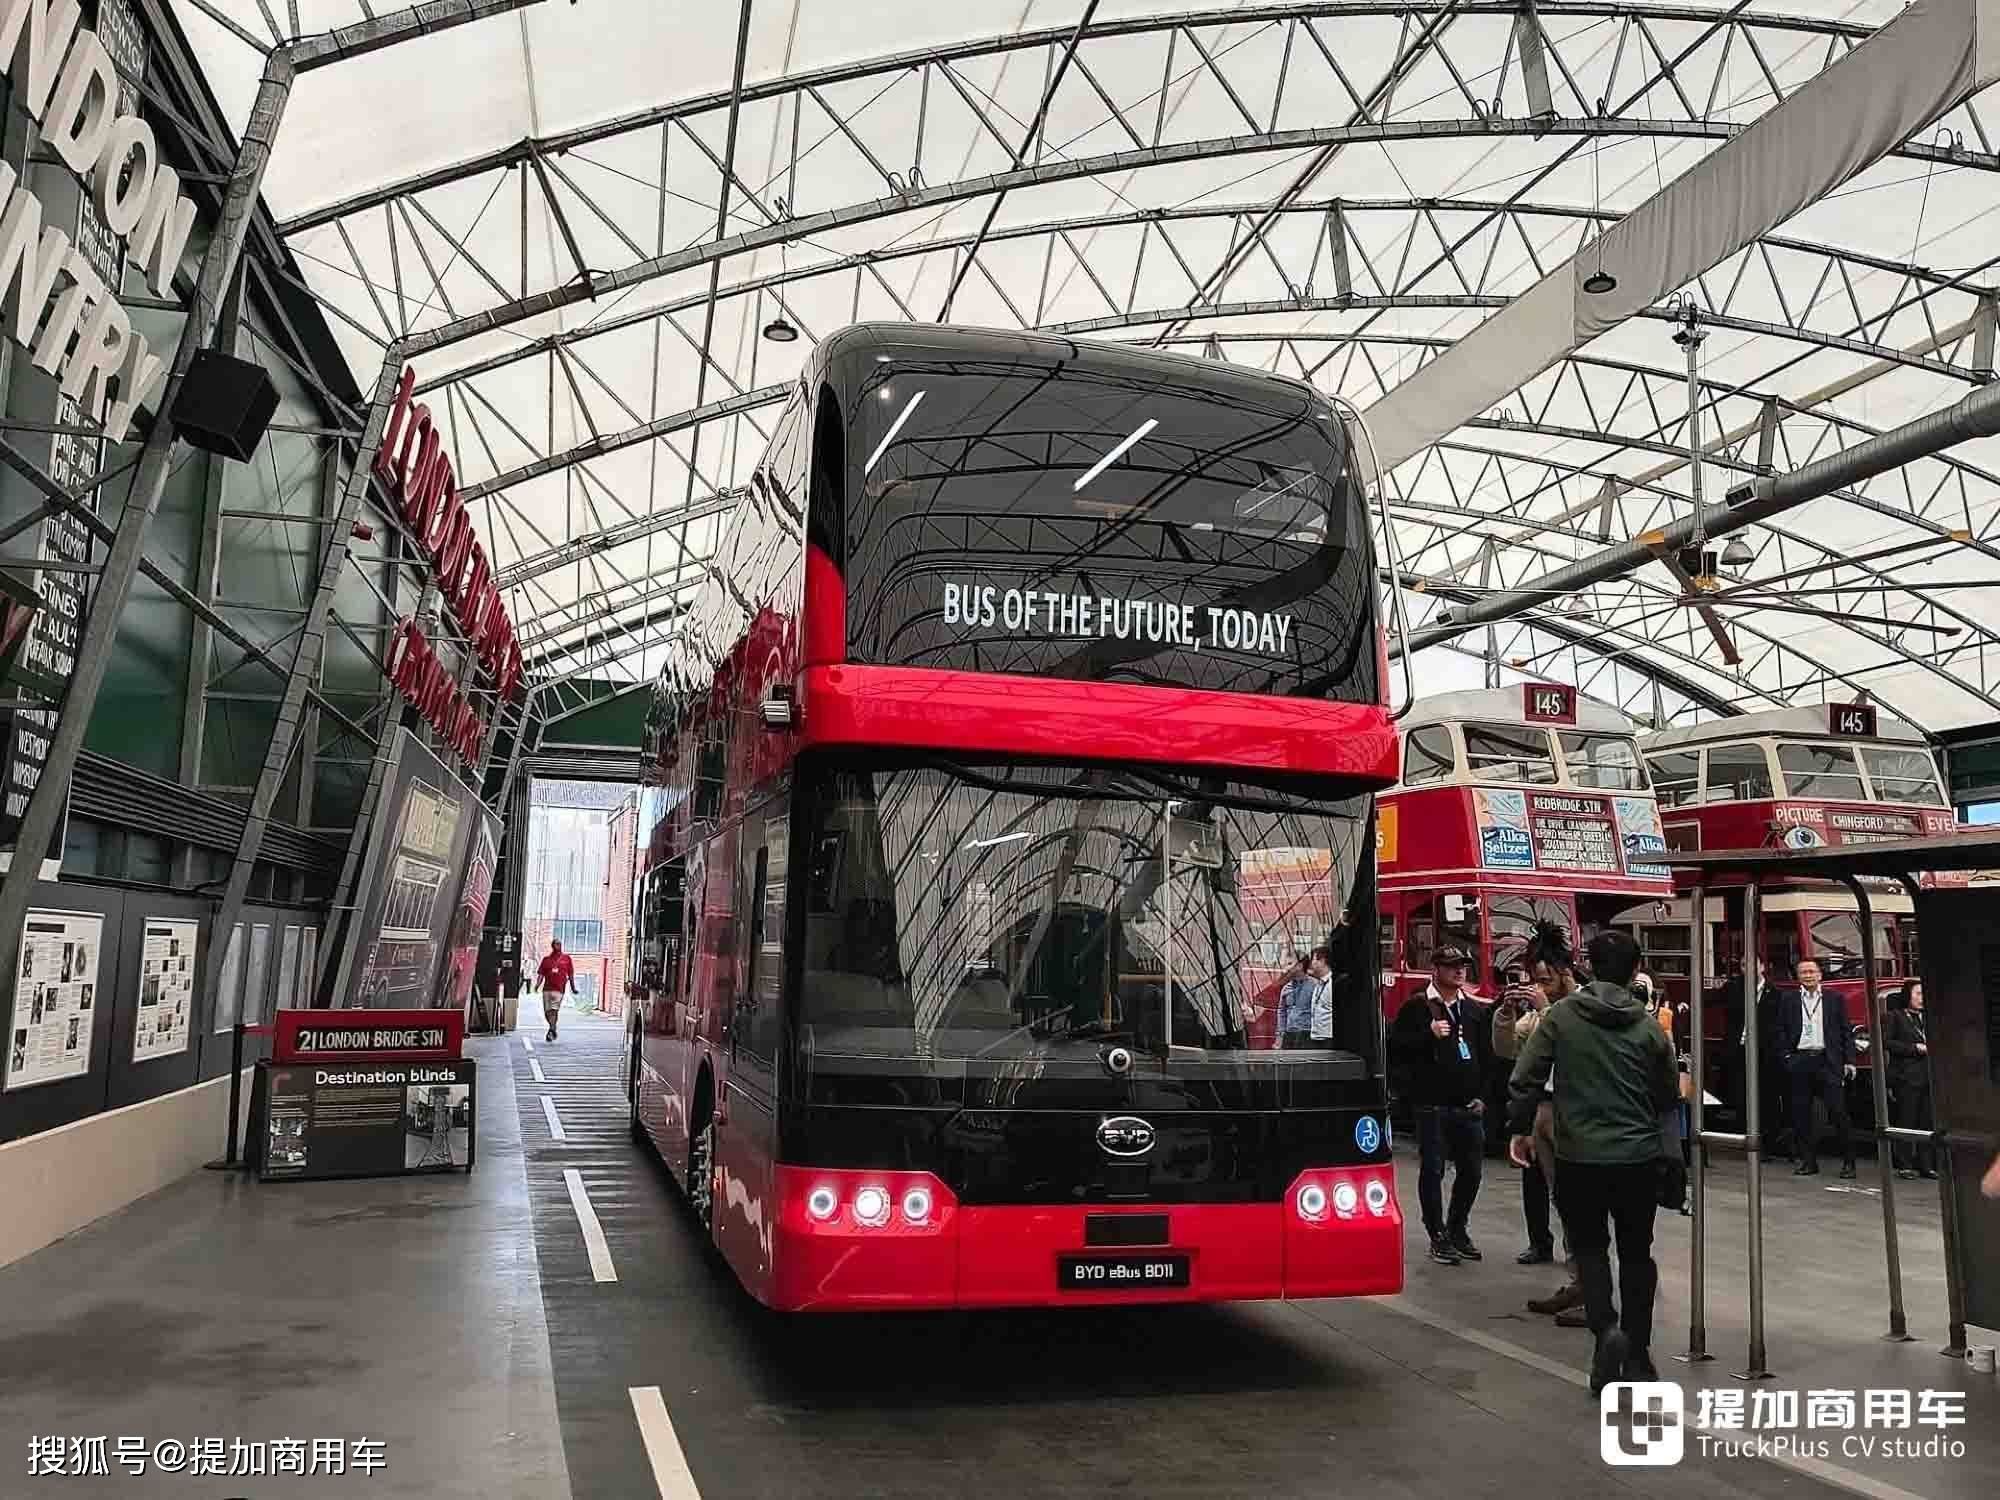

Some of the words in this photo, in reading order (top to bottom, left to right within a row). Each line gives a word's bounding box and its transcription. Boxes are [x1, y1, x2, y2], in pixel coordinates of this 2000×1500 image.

[0, 160, 162, 446] NTRY
[943, 582, 997, 628] BUS
[1003, 588, 1038, 632] OF
[1044, 592, 1092, 637] THE
[1100, 597, 1201, 652] FUTURE,
[1207, 607, 1292, 654] TODAY
[1535, 693, 1561, 717] 145
[1840, 711, 1864, 734] 145
[1533, 796, 1581, 813] REDBRIDGE
[1775, 807, 1824, 827] PICTURE
[1832, 815, 1884, 831] CHINGFORD
[1927, 815, 1954, 833] EVE
[1484, 840, 1529, 855] Seltzer
[299, 1030, 317, 1051] 21
[319, 1031, 370, 1049] LONDON
[374, 1030, 418, 1048] BRIDGE
[422, 1029, 444, 1047] STN
[315, 1070, 406, 1086] Destination
[410, 1067, 457, 1083] blinds
[1104, 1129, 1150, 1145] BYD
[1109, 1264, 1141, 1279] eBus
